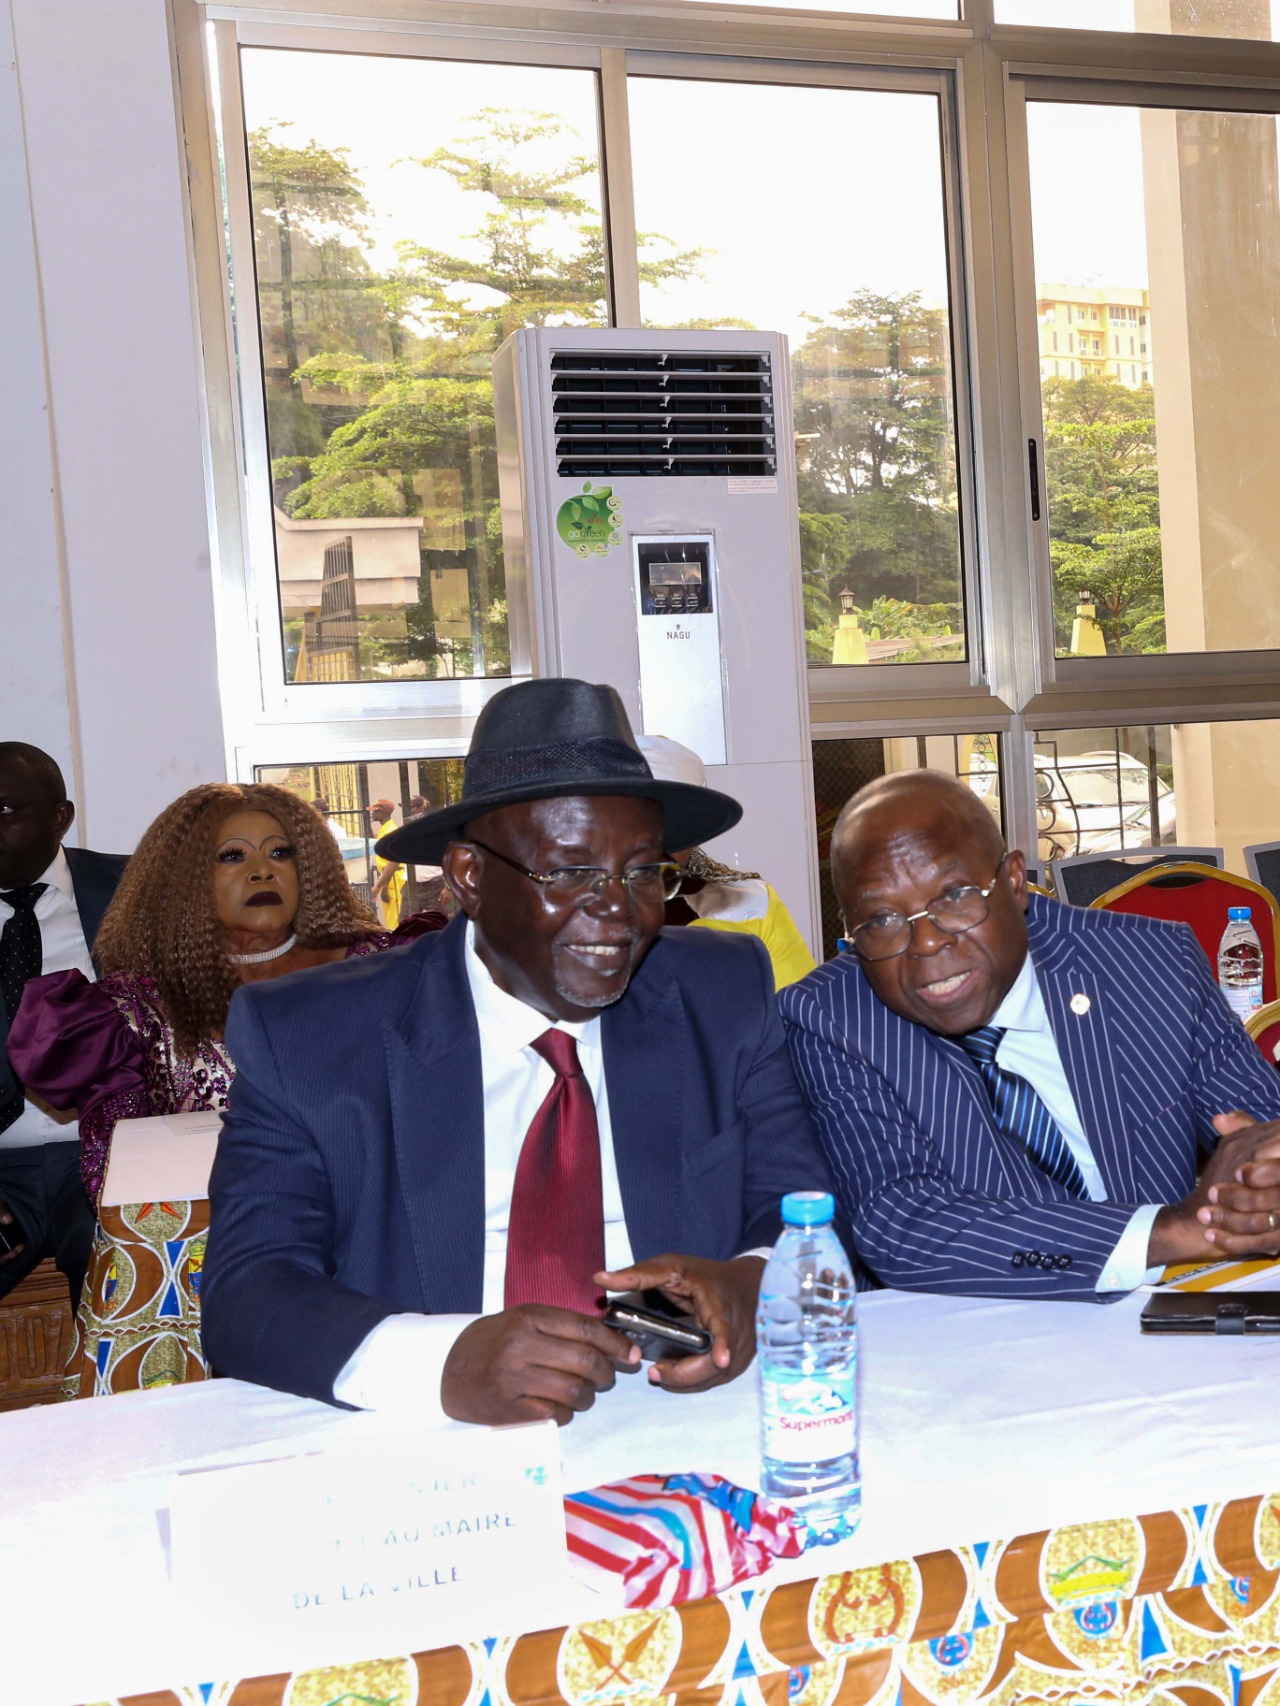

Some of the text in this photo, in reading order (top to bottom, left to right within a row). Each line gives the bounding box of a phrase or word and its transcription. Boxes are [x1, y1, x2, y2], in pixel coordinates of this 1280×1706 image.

[666, 631, 691, 640] NAGU
[384, 1528, 420, 1545] AU
[432, 1511, 517, 1539] MAIRE
[341, 1582, 374, 1601] LA
